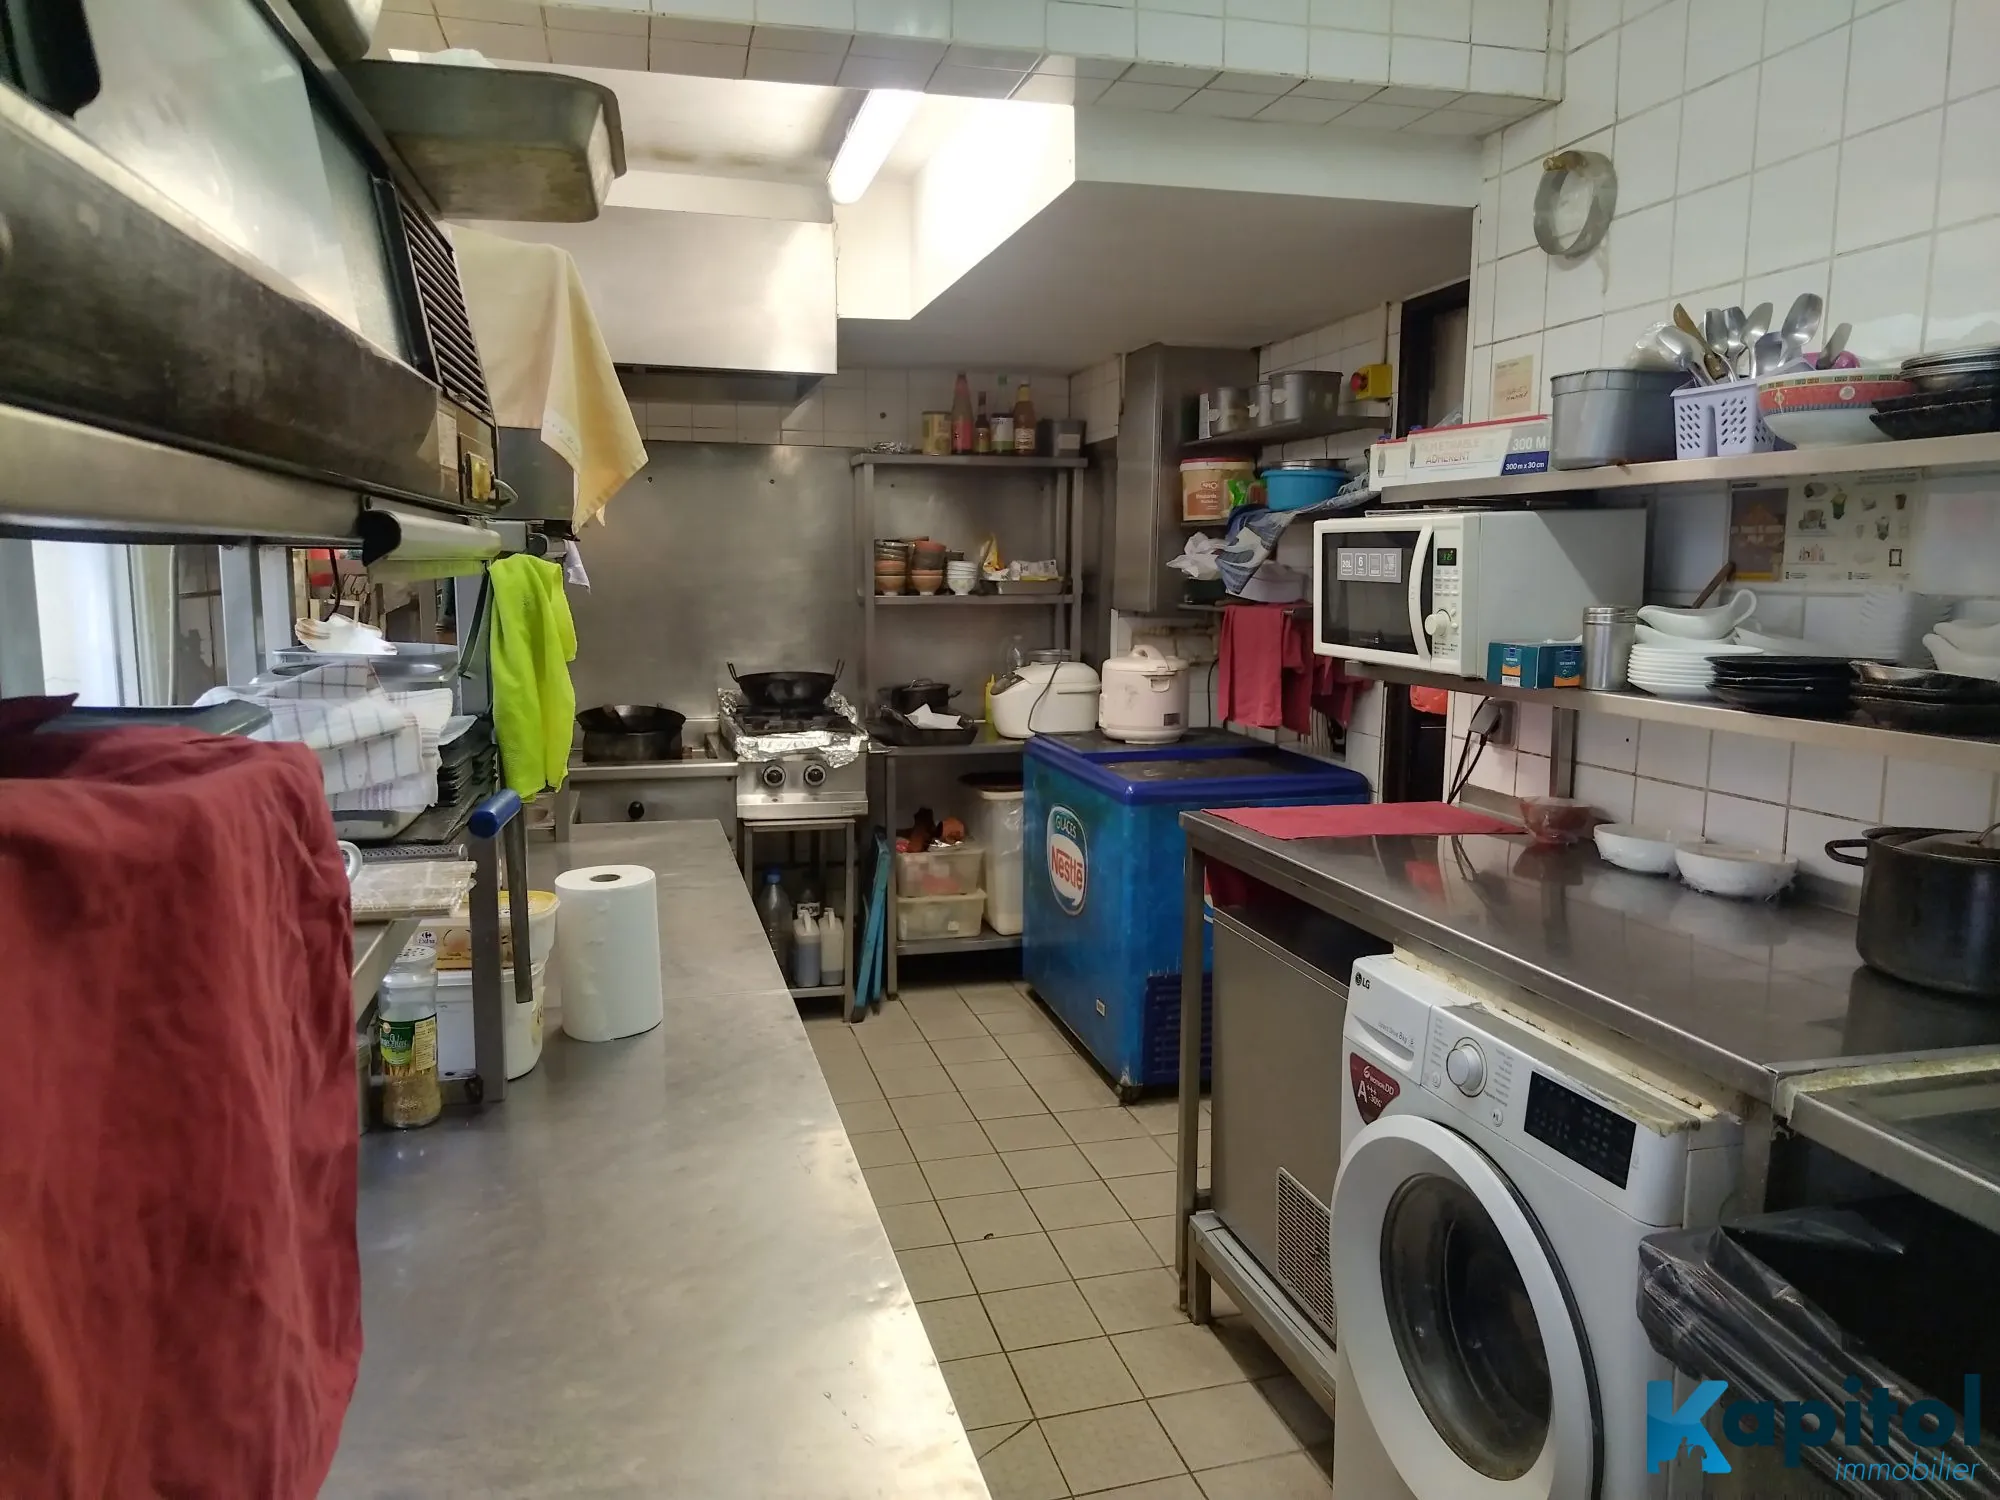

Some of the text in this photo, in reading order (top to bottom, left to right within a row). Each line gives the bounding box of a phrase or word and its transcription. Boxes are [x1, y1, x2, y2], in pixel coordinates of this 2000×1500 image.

[1512, 435, 1547, 451] 300 M
[1505, 462, 1518, 470] 300
[1527, 461, 1536, 469] 30
[1055, 815, 1077, 839] GLACES
[1362, 977, 1371, 990] LG
